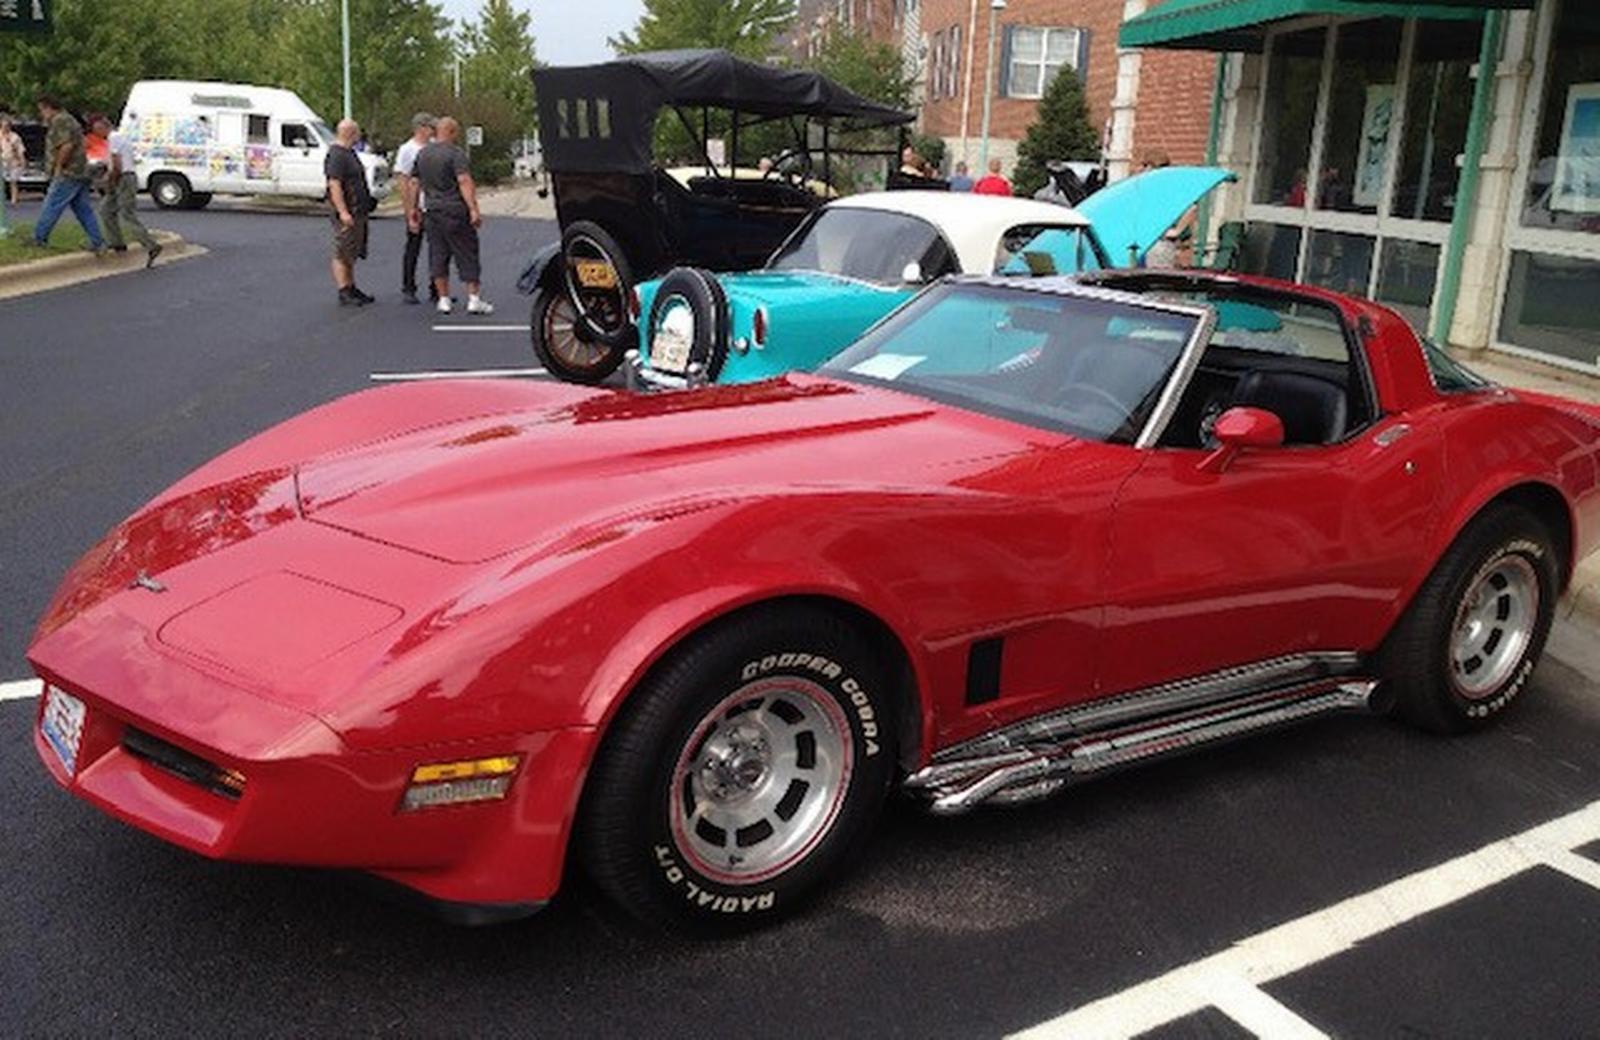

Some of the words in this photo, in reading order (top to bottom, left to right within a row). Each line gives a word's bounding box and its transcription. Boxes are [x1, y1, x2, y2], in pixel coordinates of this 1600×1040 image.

[741, 653, 842, 680] COOPER
[840, 677, 880, 757] COBRA
[685, 881, 776, 913] RADIAL
